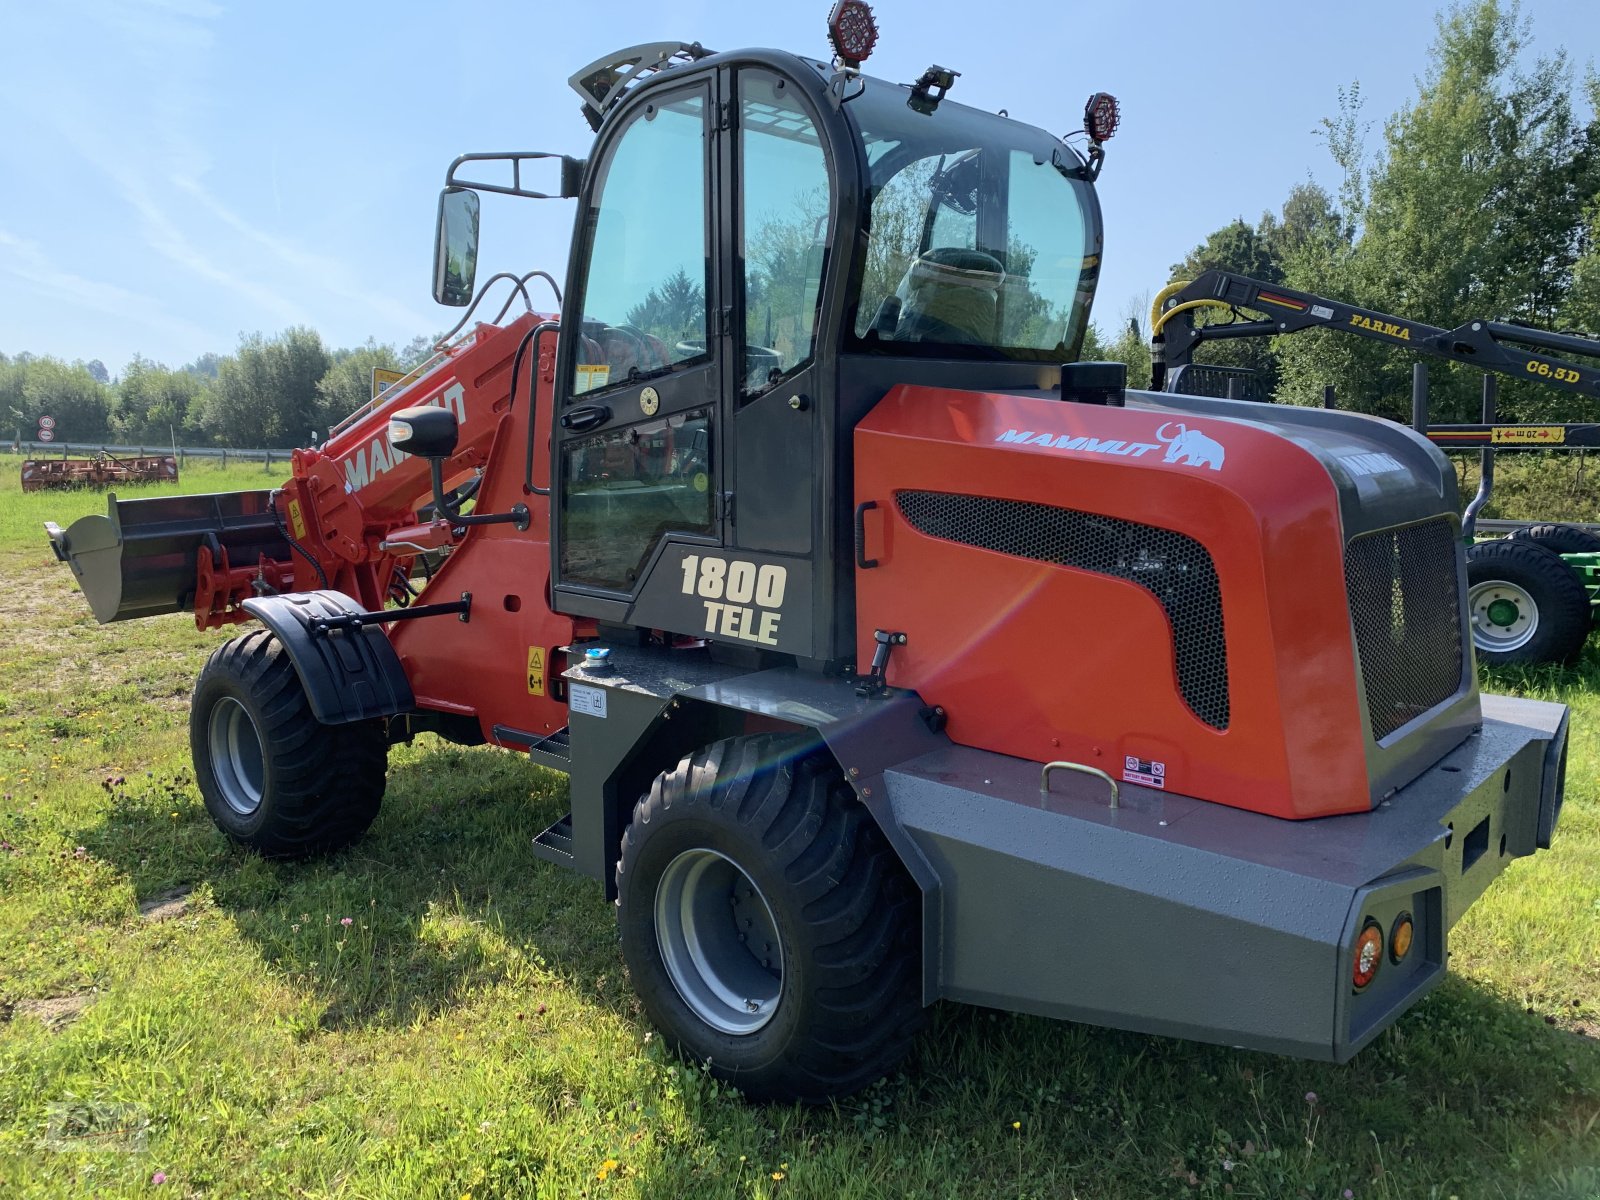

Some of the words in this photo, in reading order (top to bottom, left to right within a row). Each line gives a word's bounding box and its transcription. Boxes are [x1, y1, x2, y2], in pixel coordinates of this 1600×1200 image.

[1349, 313, 1411, 341] FARMA
[1526, 360, 1580, 384] C6,3D
[995, 429, 1161, 457] MAMMUT
[681, 554, 787, 608] 1800
[703, 600, 781, 645] TELE
